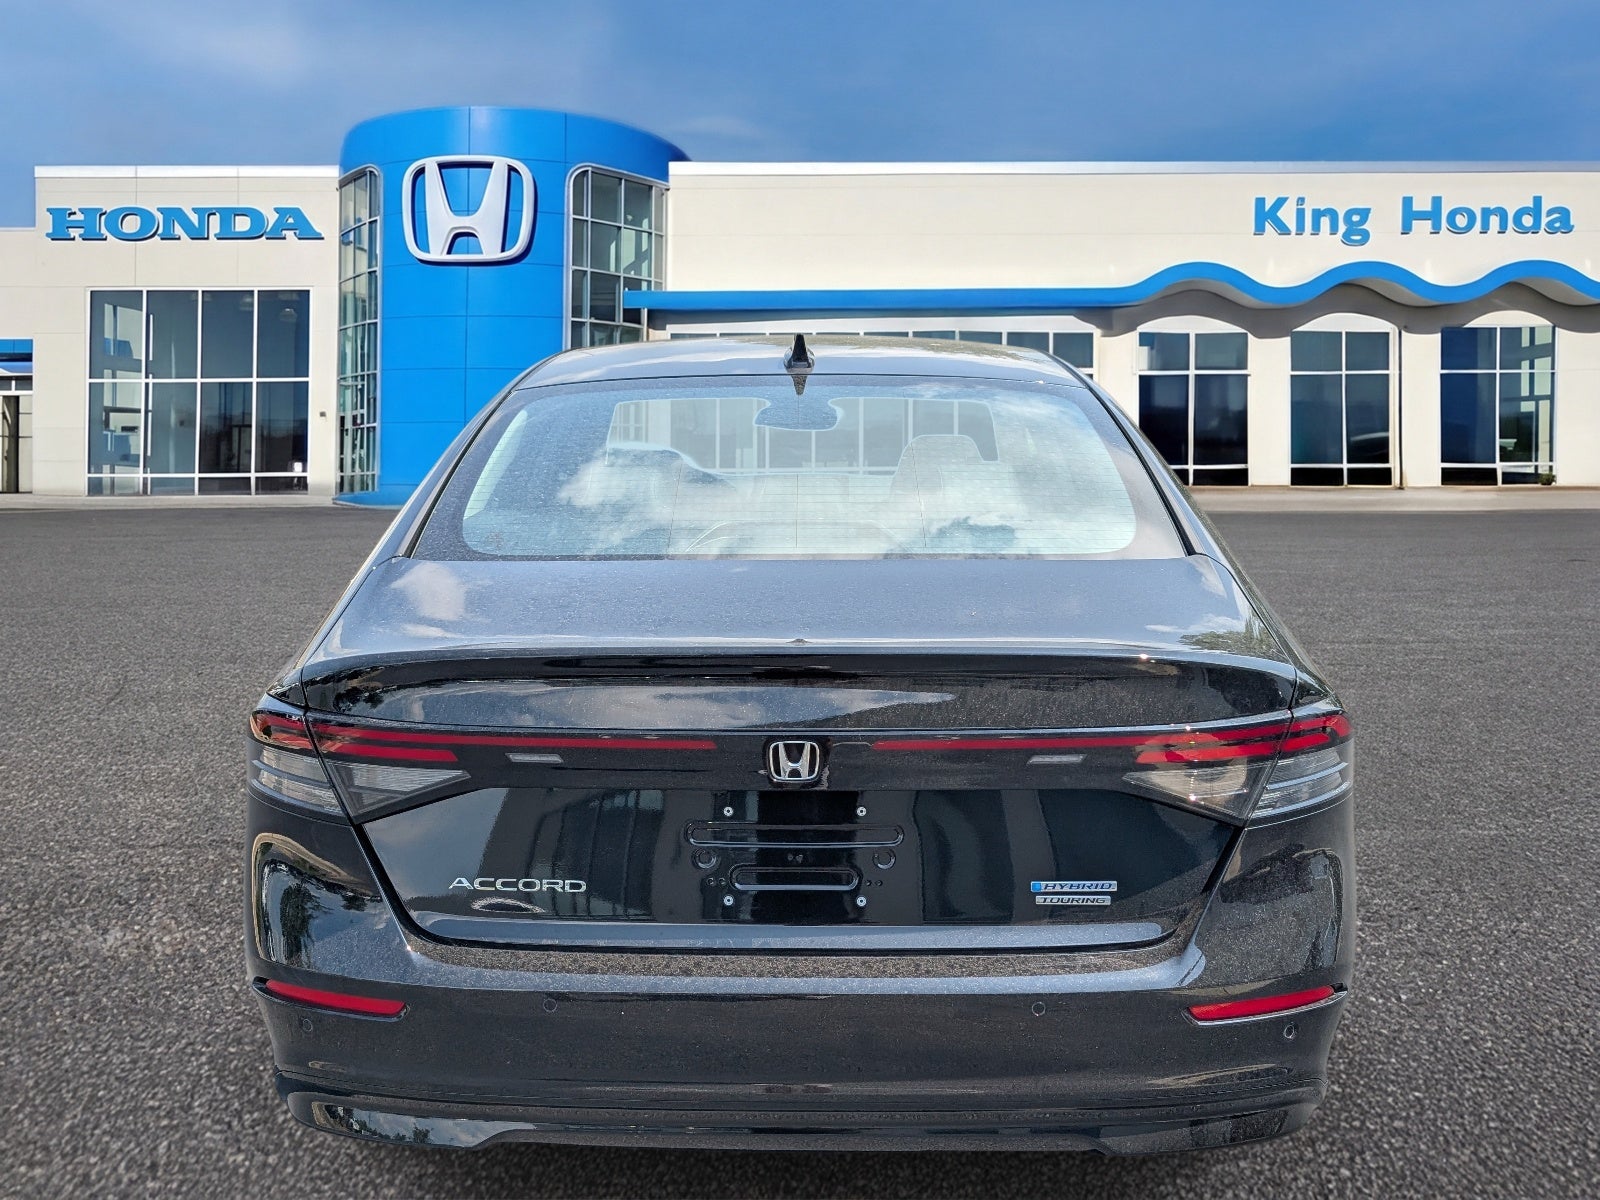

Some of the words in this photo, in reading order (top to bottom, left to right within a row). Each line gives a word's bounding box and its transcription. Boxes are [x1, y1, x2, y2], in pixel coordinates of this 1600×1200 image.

[46, 206, 325, 241] HONDA
[1253, 196, 1372, 246] King
[1401, 195, 1575, 234] Honda
[448, 877, 587, 893] ACCORD
[1043, 882, 1114, 890] HYBRID
